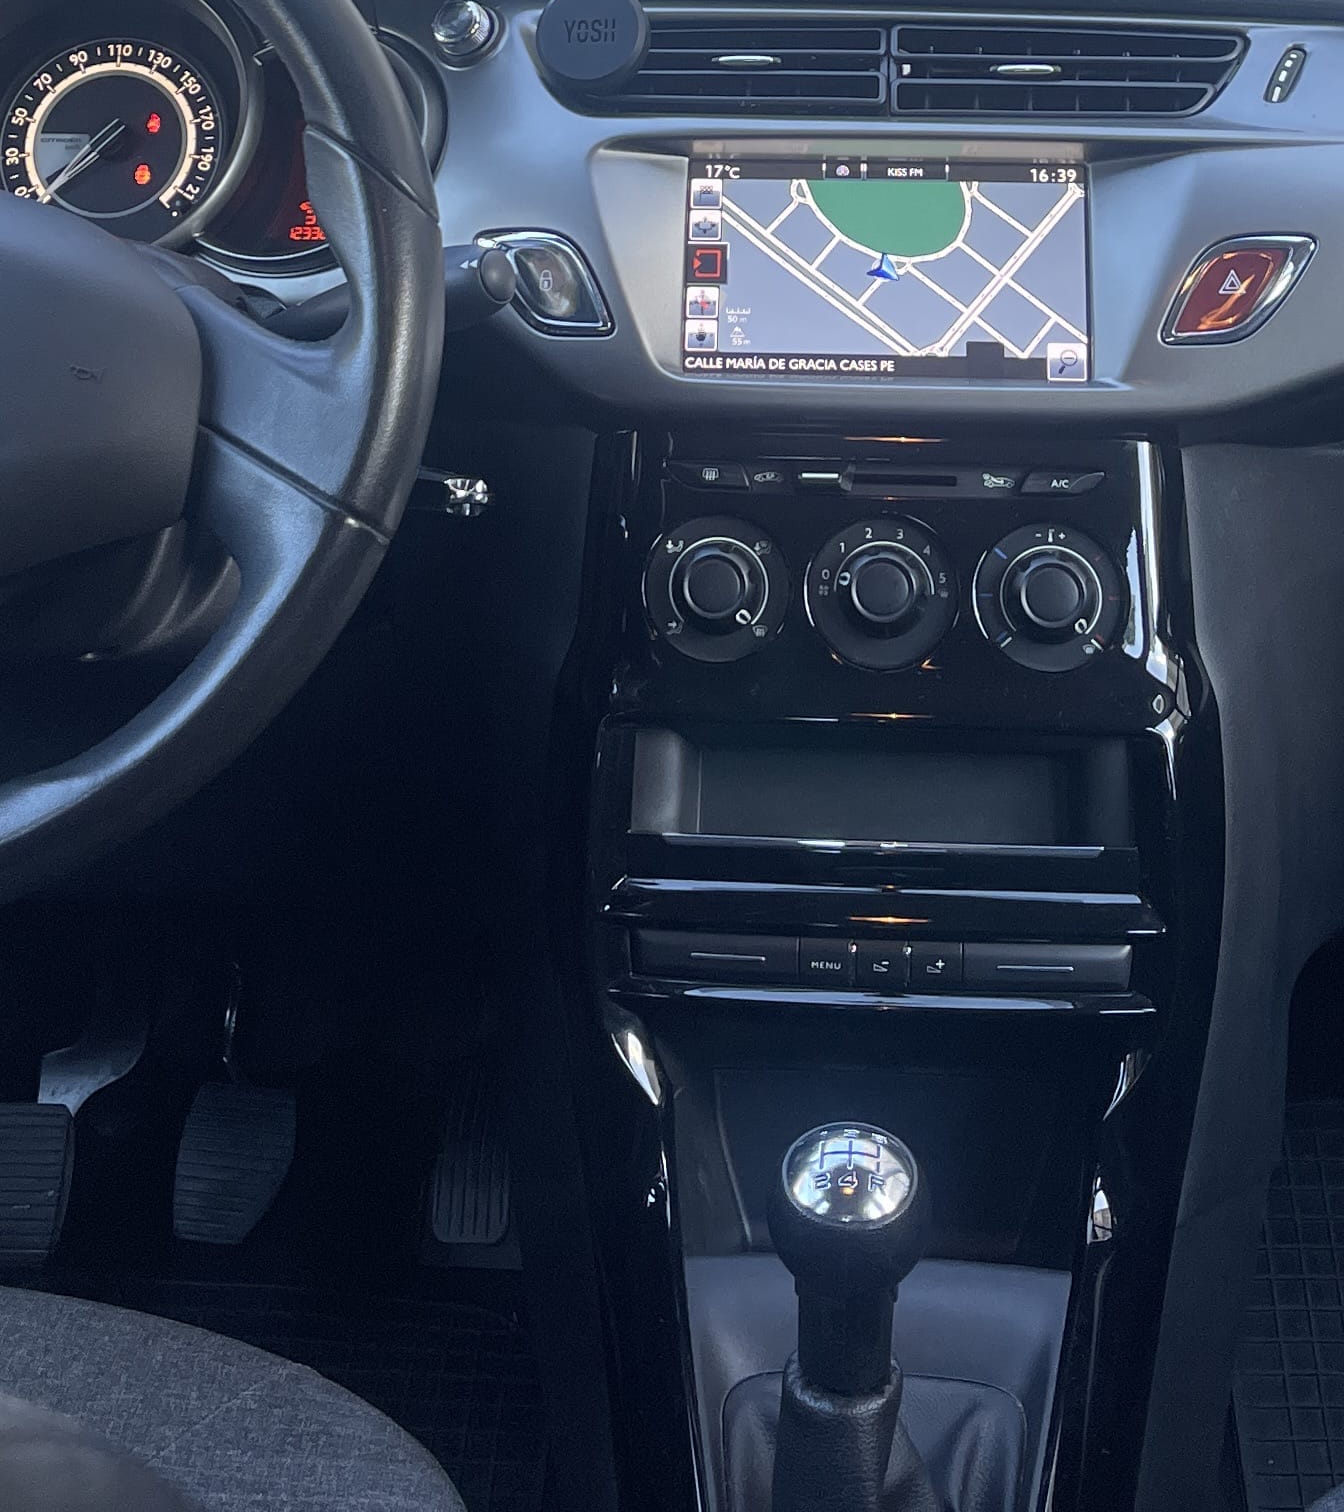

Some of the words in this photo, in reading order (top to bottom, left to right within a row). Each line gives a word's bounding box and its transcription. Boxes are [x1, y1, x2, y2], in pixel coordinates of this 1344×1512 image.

[564, 18, 616, 44] YOSH
[107, 44, 133, 57] 110
[69, 51, 88, 66] 90
[149, 49, 172, 69] 130
[33, 73, 53, 91] 70
[179, 71, 201, 94] 150
[11, 107, 28, 126] 50
[199, 106, 215, 131] 170
[5, 148, 19, 166] 30
[197, 146, 214, 171] 190
[706, 164, 740, 179] 17°C
[887, 167, 907, 177] KISS
[908, 167, 923, 177] FM
[1030, 168, 1077, 183] 16:39
[727, 315, 738, 324] 50
[732, 338, 742, 346] 55
[684, 357, 723, 369] CALLE
[725, 355, 766, 370] MARÍA
[768, 358, 786, 370] DE
[788, 358, 837, 371] GRACIA
[839, 359, 877, 372] CASES
[879, 360, 895, 372] PE
[1051, 479, 1070, 489] A/C
[864, 528, 873, 539] 2
[896, 529, 904, 540] 3
[839, 542, 845, 553] 1
[923, 545, 931, 557] 4
[821, 569, 830, 581] 0
[938, 573, 946, 584] 5
[811, 961, 841, 970] MENU
[814, 1172, 831, 1191] 2
[838, 1170, 858, 1188] 4
[868, 1173, 887, 1196] R
